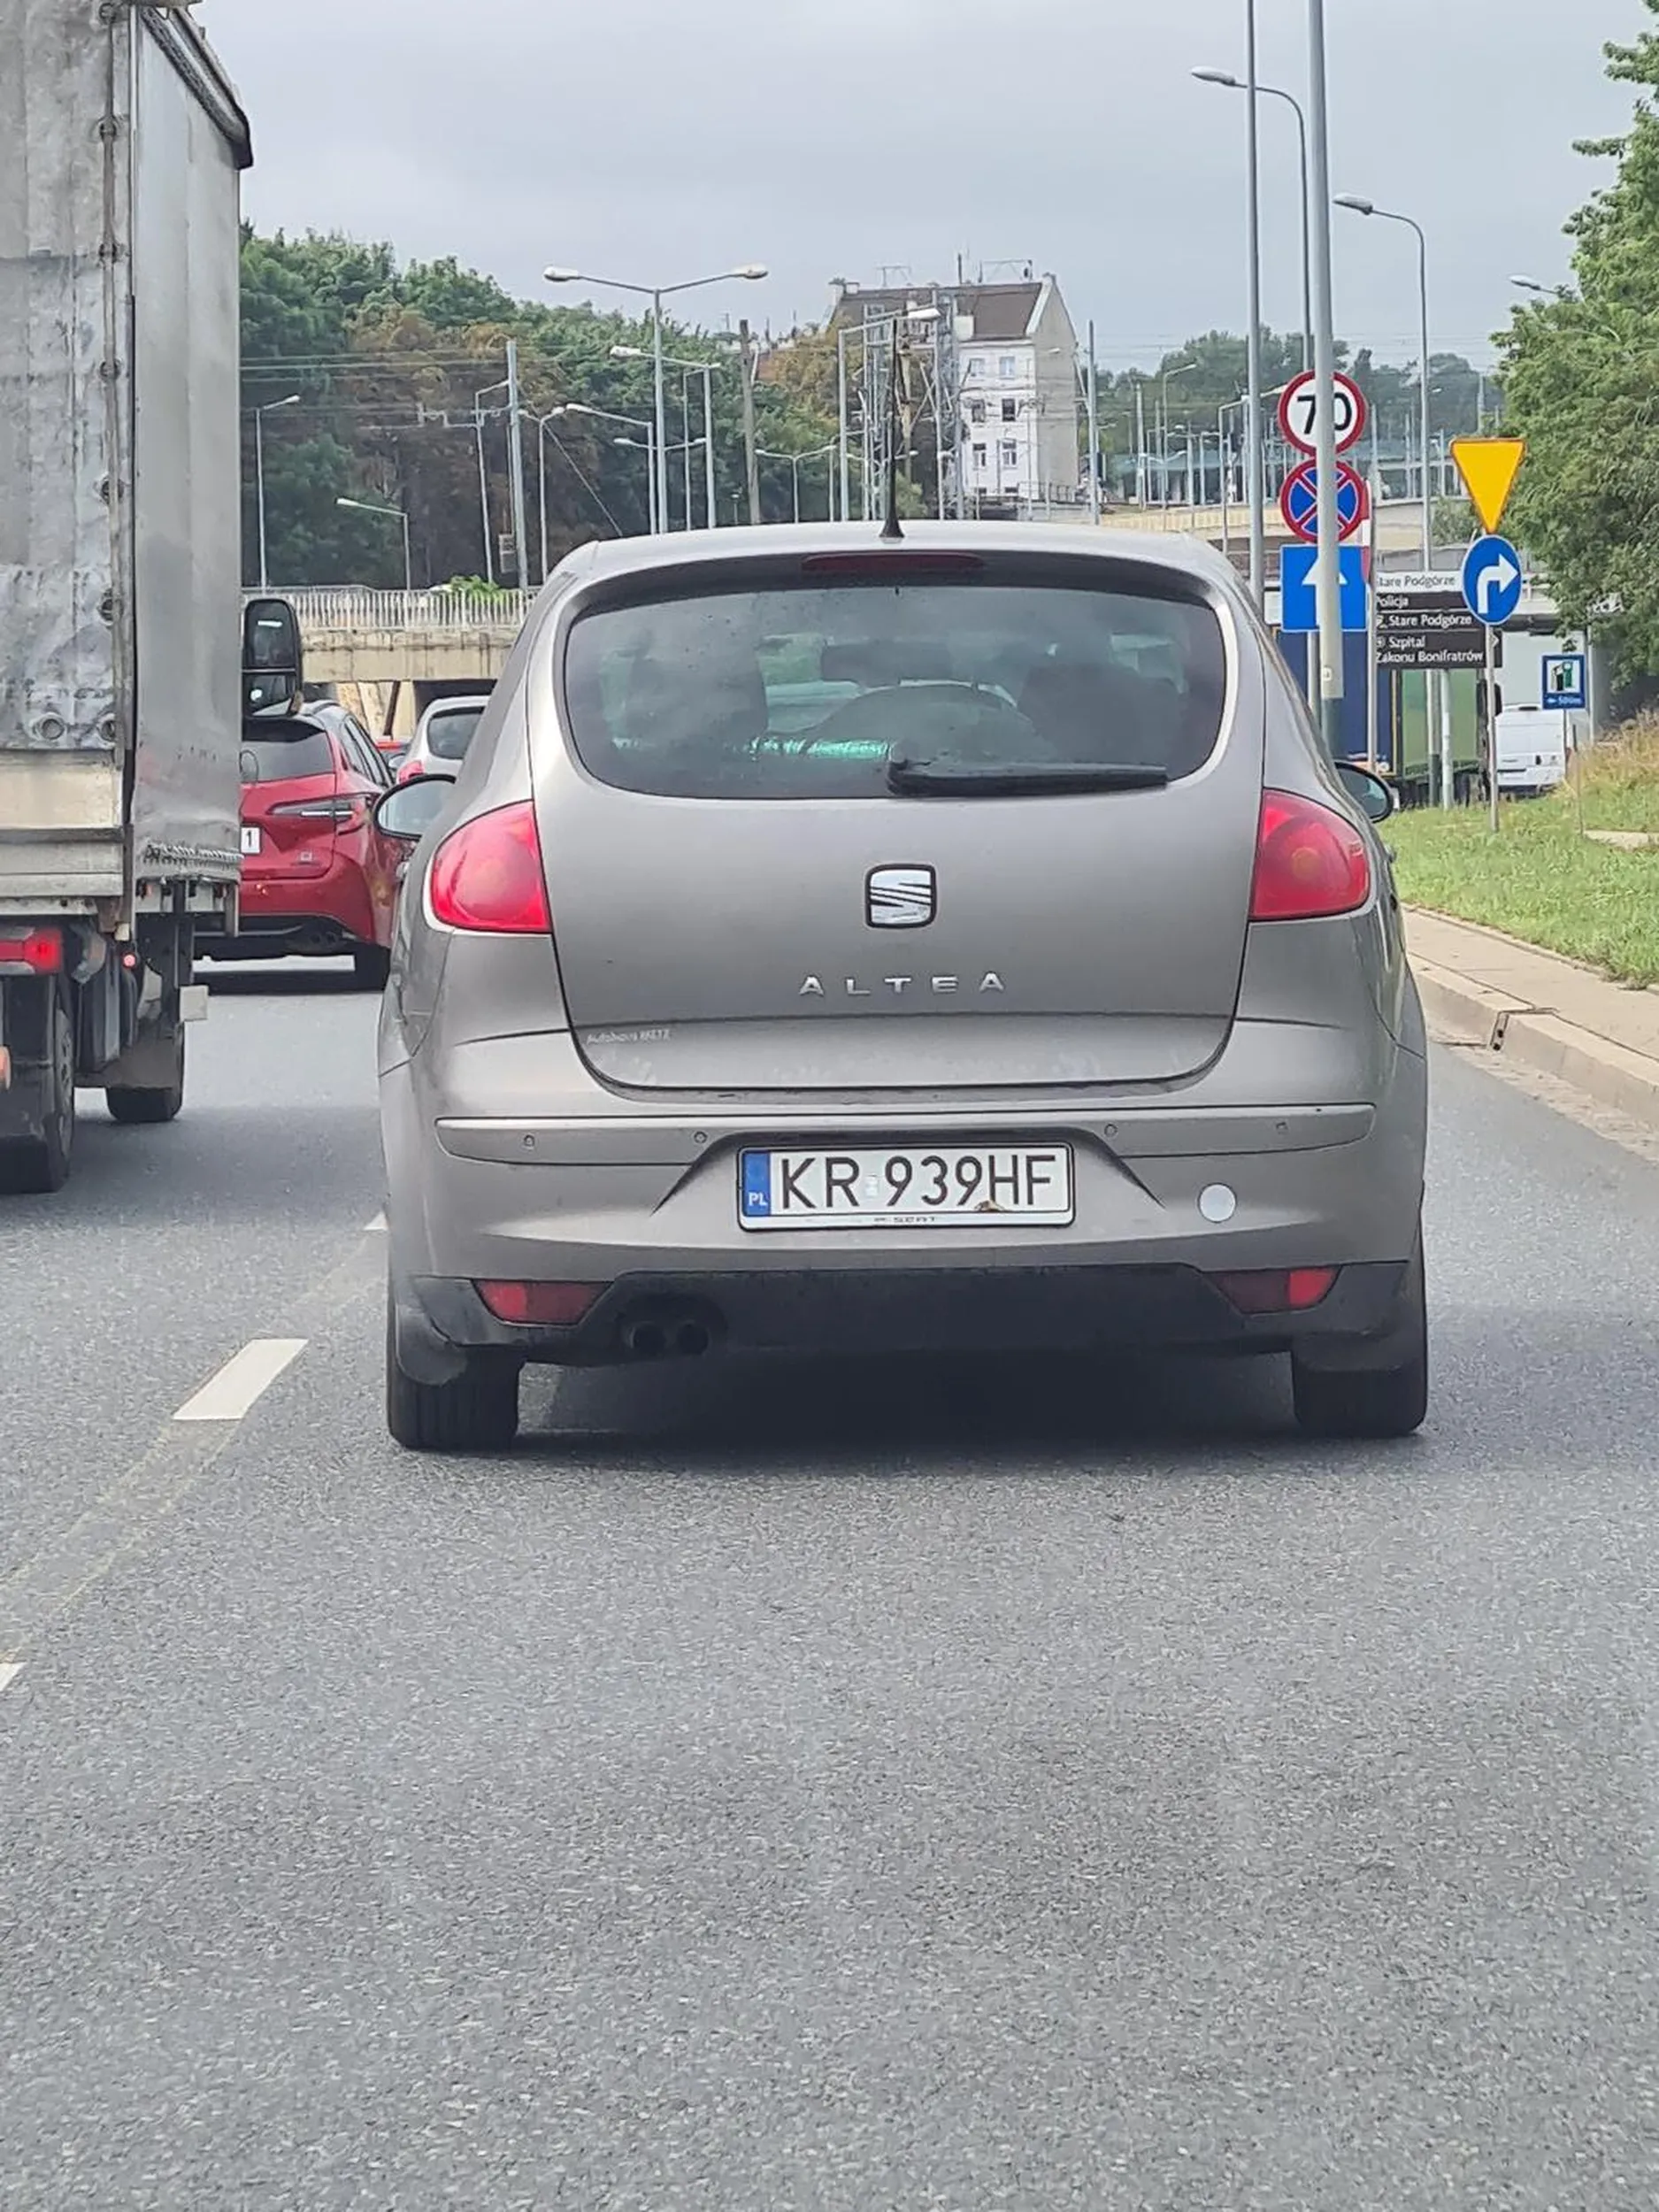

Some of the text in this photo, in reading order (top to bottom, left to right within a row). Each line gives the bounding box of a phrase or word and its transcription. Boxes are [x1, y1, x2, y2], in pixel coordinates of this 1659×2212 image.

[1297, 392, 1353, 434] 70
[1378, 575, 1455, 588] tare Podgórze
[1388, 613, 1472, 629] Stare Podgórze
[1388, 635, 1426, 650] Szpital
[1376, 649, 1484, 663] Zakonu Bonifratrów
[798, 971, 1004, 996] ALTEA
[781, 1154, 1056, 1209] KR 939HF
[748, 1190, 768, 1206] PL
